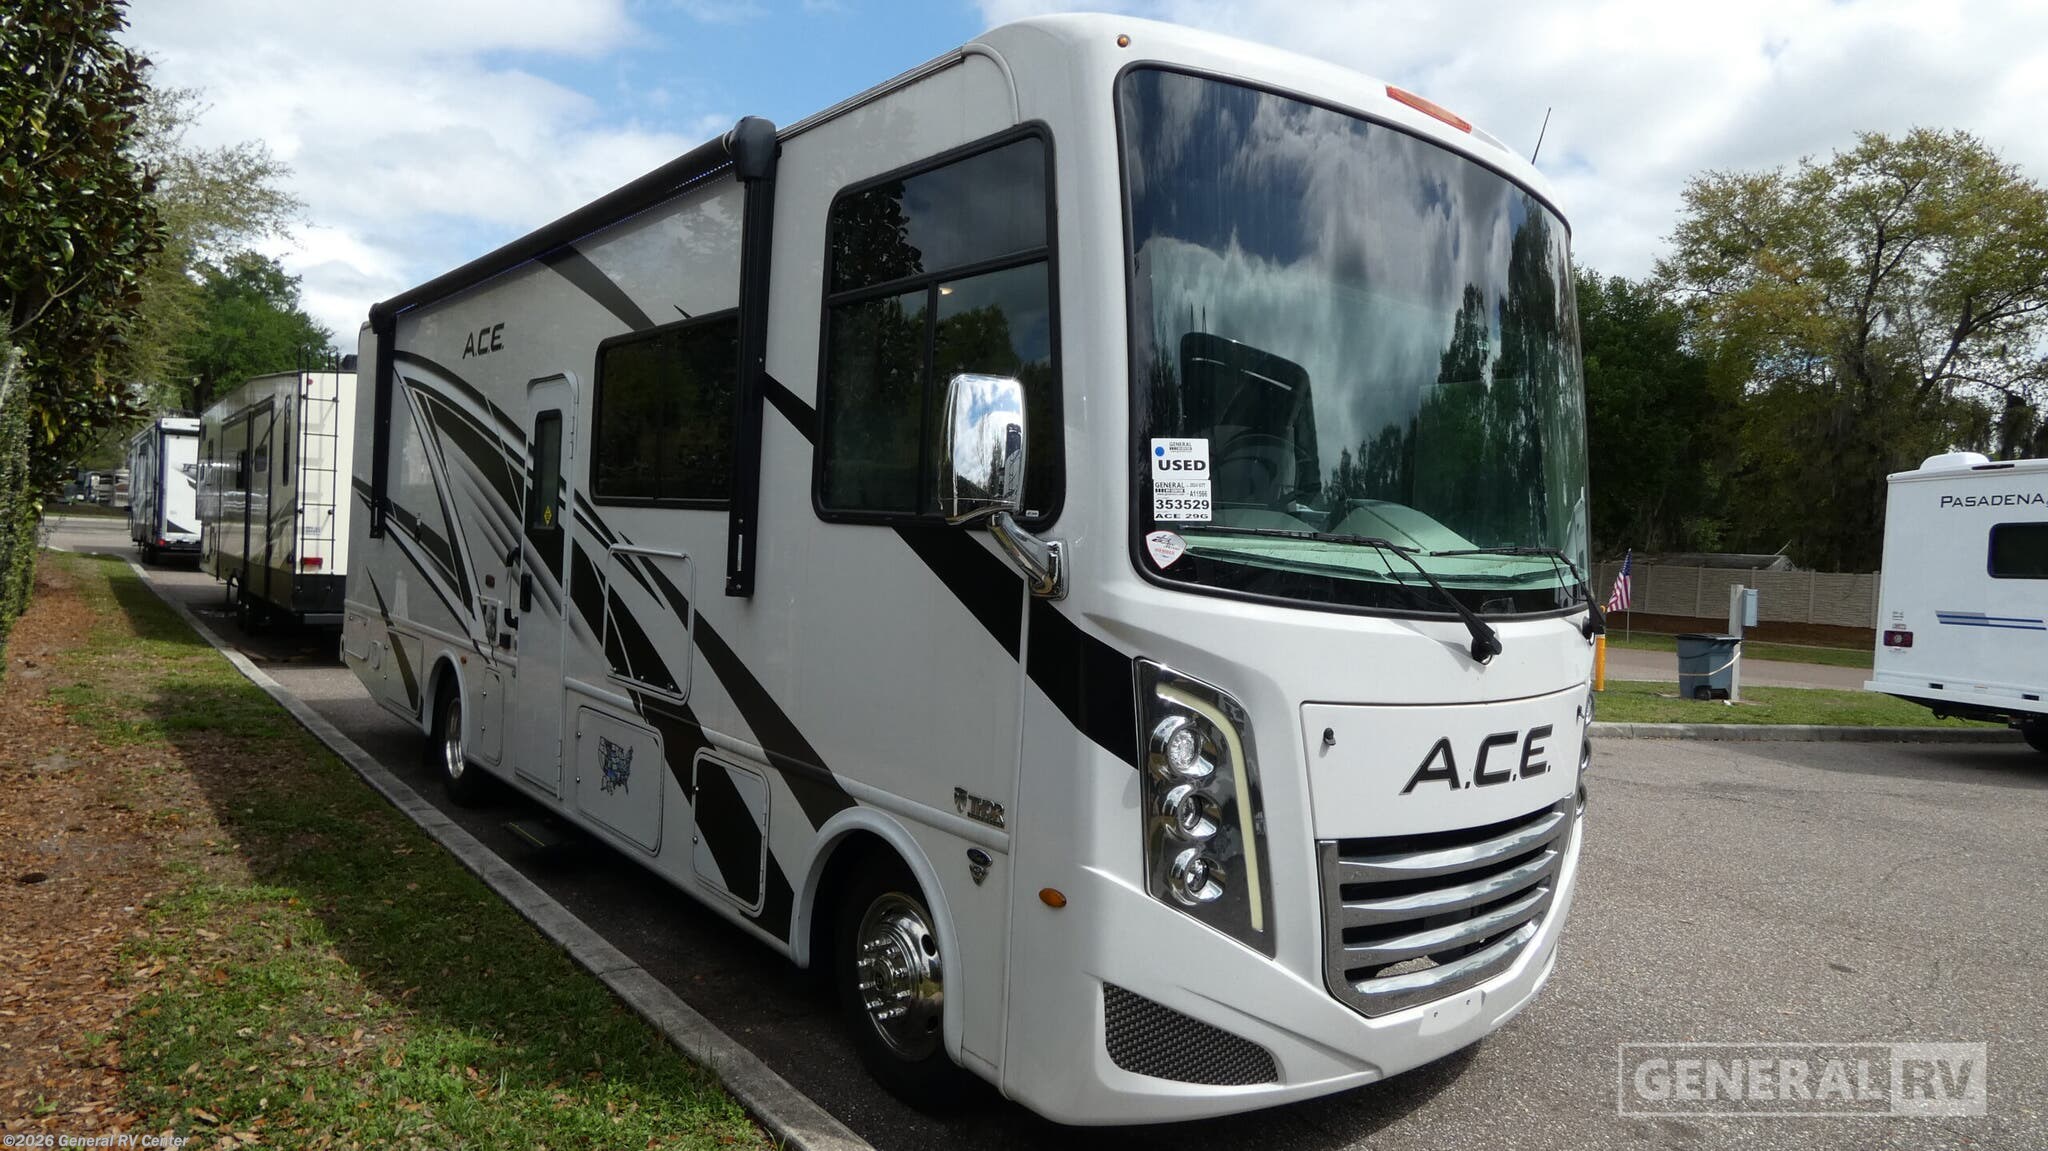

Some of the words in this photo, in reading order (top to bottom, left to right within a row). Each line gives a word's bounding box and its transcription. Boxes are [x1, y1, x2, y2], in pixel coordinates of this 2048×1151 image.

[1158, 459, 1206, 471] USED
[1155, 499, 1210, 510] 353529
[1940, 493, 2045, 508] PASADENA
[1399, 723, 1553, 796] A.C.E.
